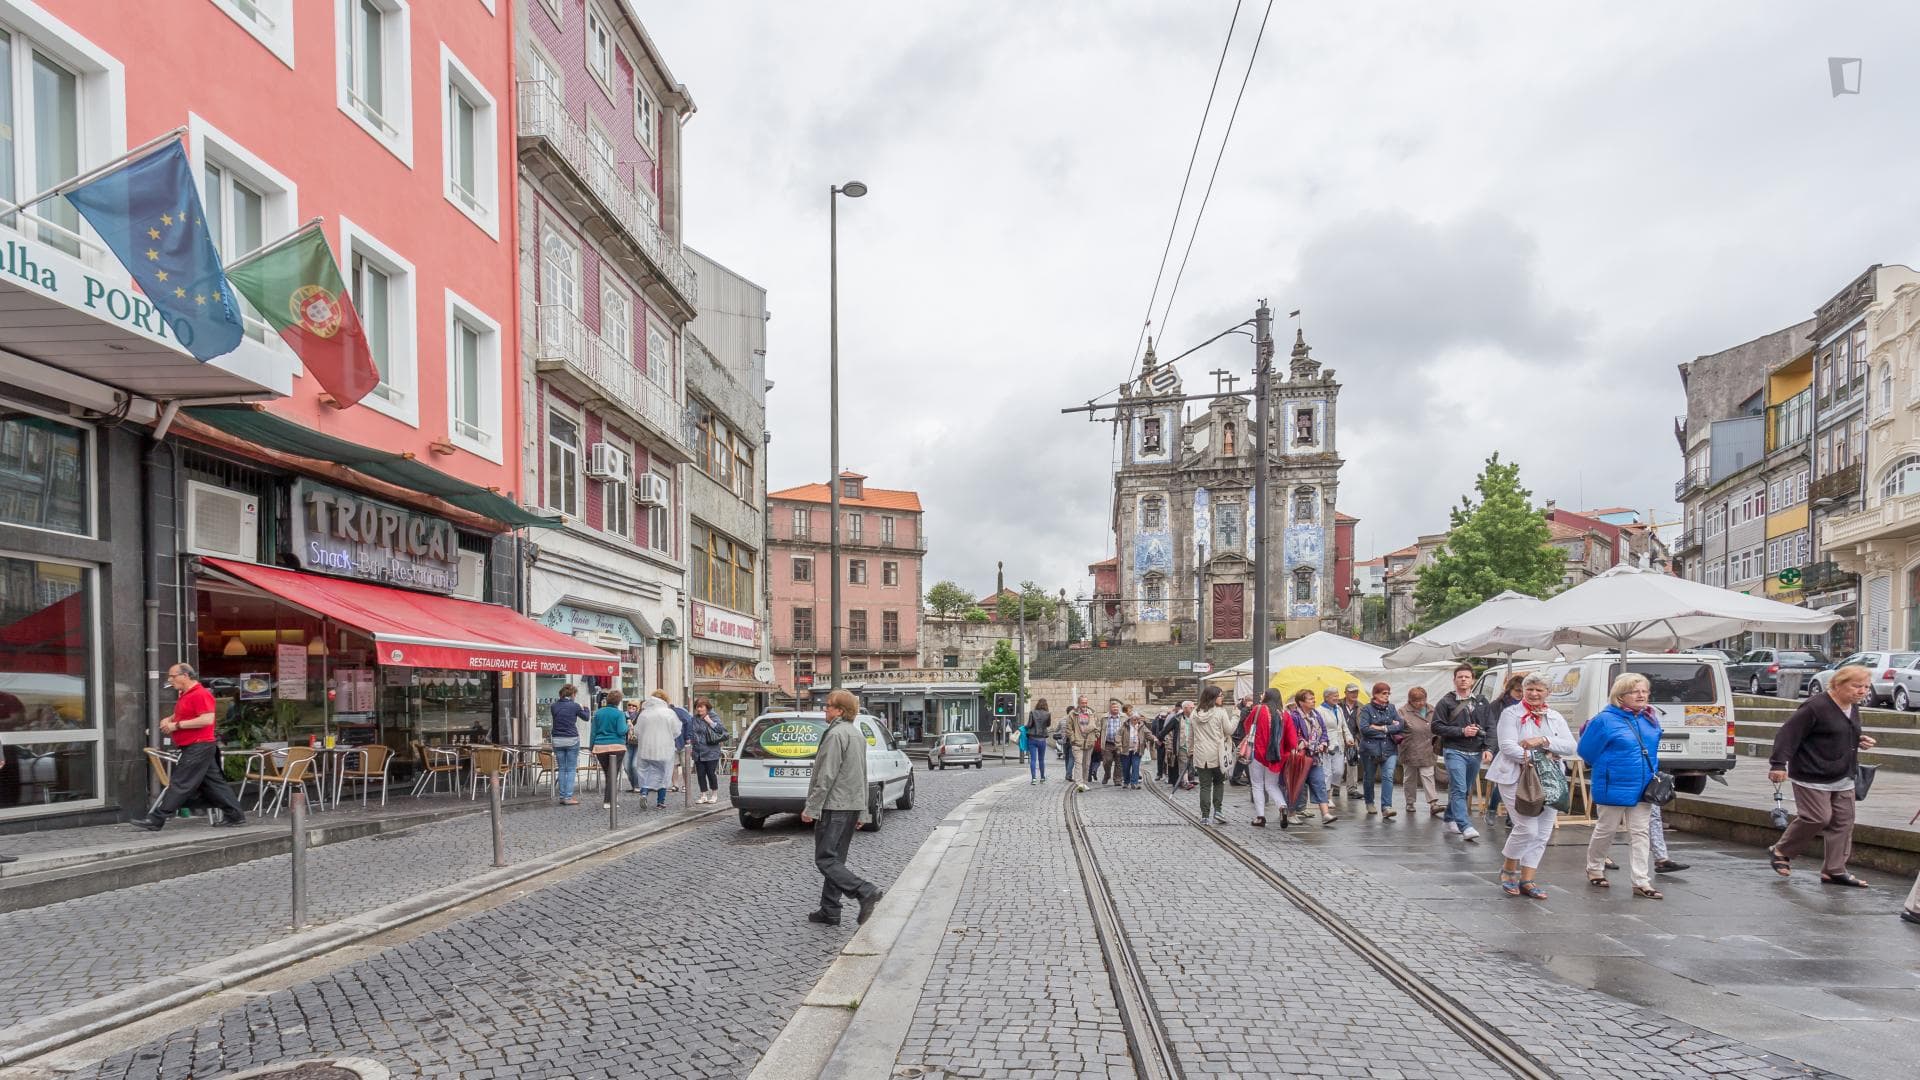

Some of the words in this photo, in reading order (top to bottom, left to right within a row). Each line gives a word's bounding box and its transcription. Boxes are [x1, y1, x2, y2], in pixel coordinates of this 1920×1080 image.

[83, 275, 194, 348] PORTO
[308, 491, 461, 563] TROPICAL
[469, 657, 518, 669] RESTAURANTE
[521, 659, 537, 670] CAFÉ
[540, 662, 568, 672] TROPICAL
[771, 732, 818, 742] SEGUROS
[780, 725, 812, 734] LOJAS
